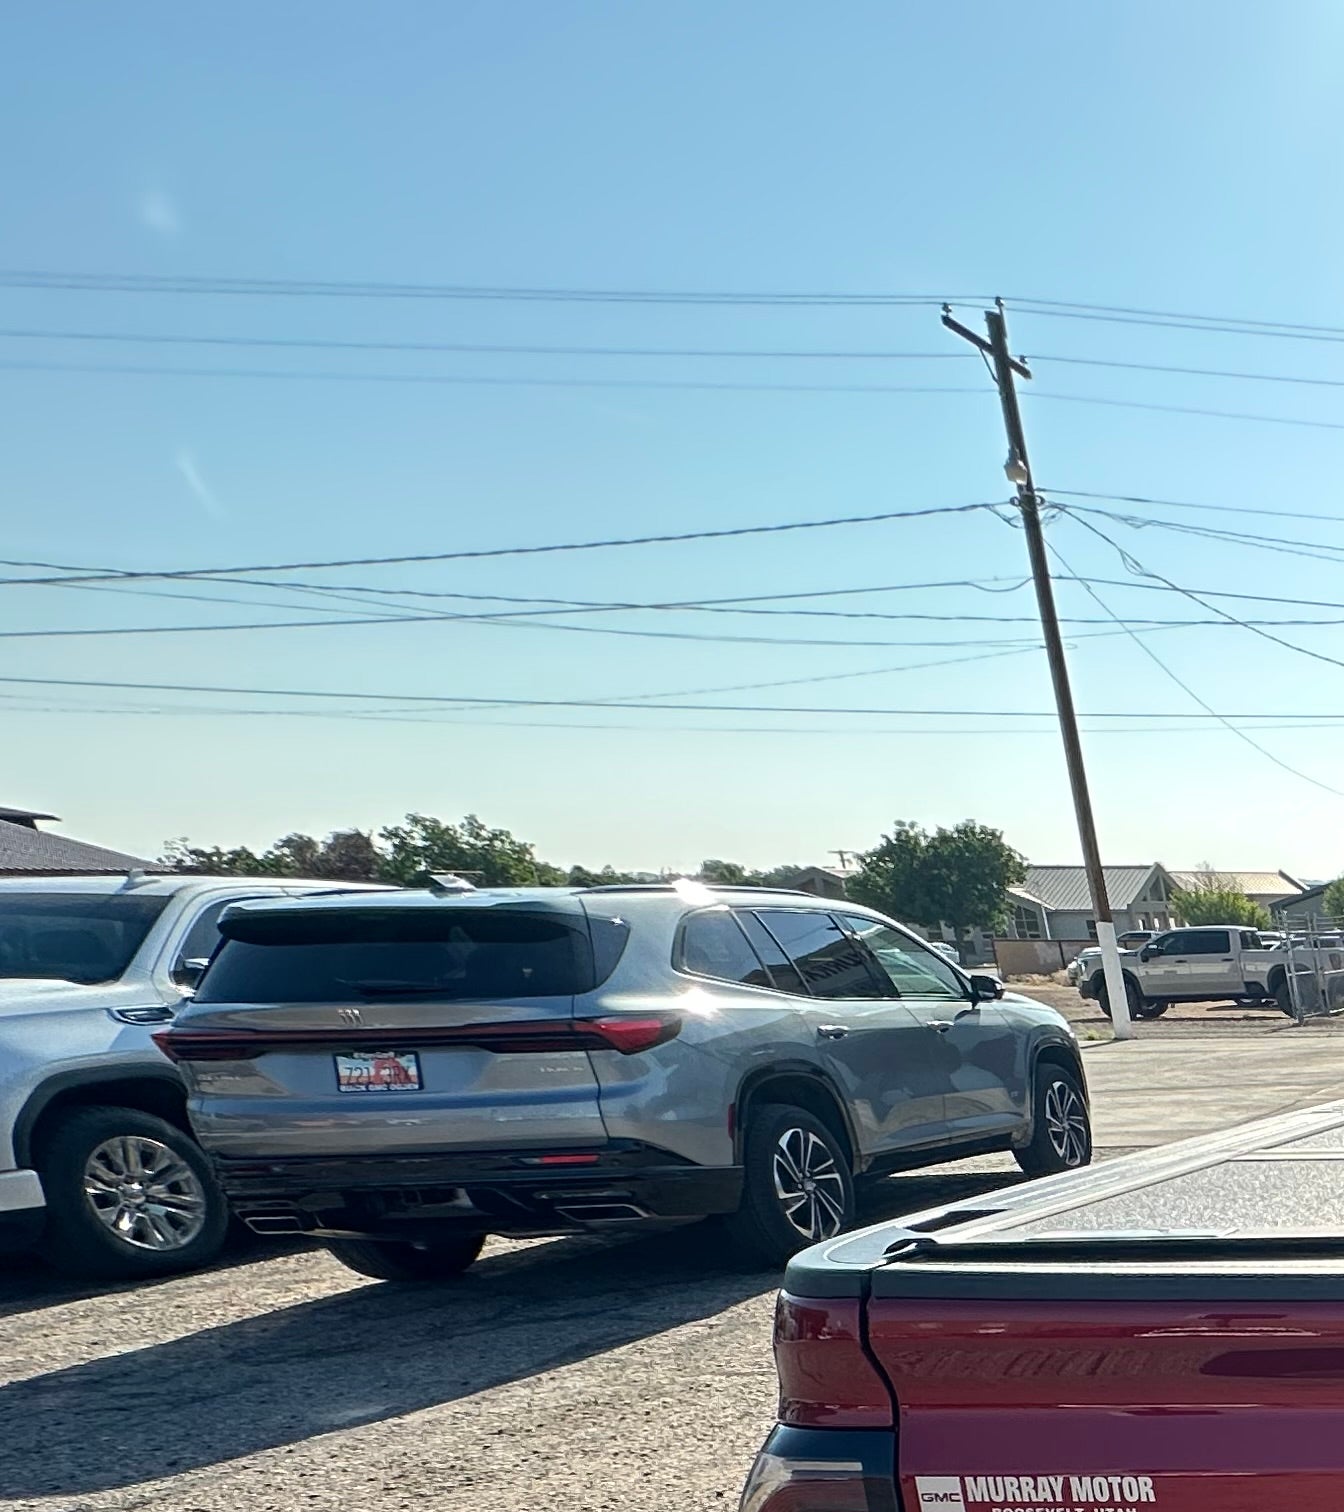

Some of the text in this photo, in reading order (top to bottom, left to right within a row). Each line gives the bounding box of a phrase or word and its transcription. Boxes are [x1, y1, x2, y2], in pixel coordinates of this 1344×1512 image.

[921, 1493, 961, 1503] GMC
[965, 1476, 1156, 1503] MURRAY MOTOR
